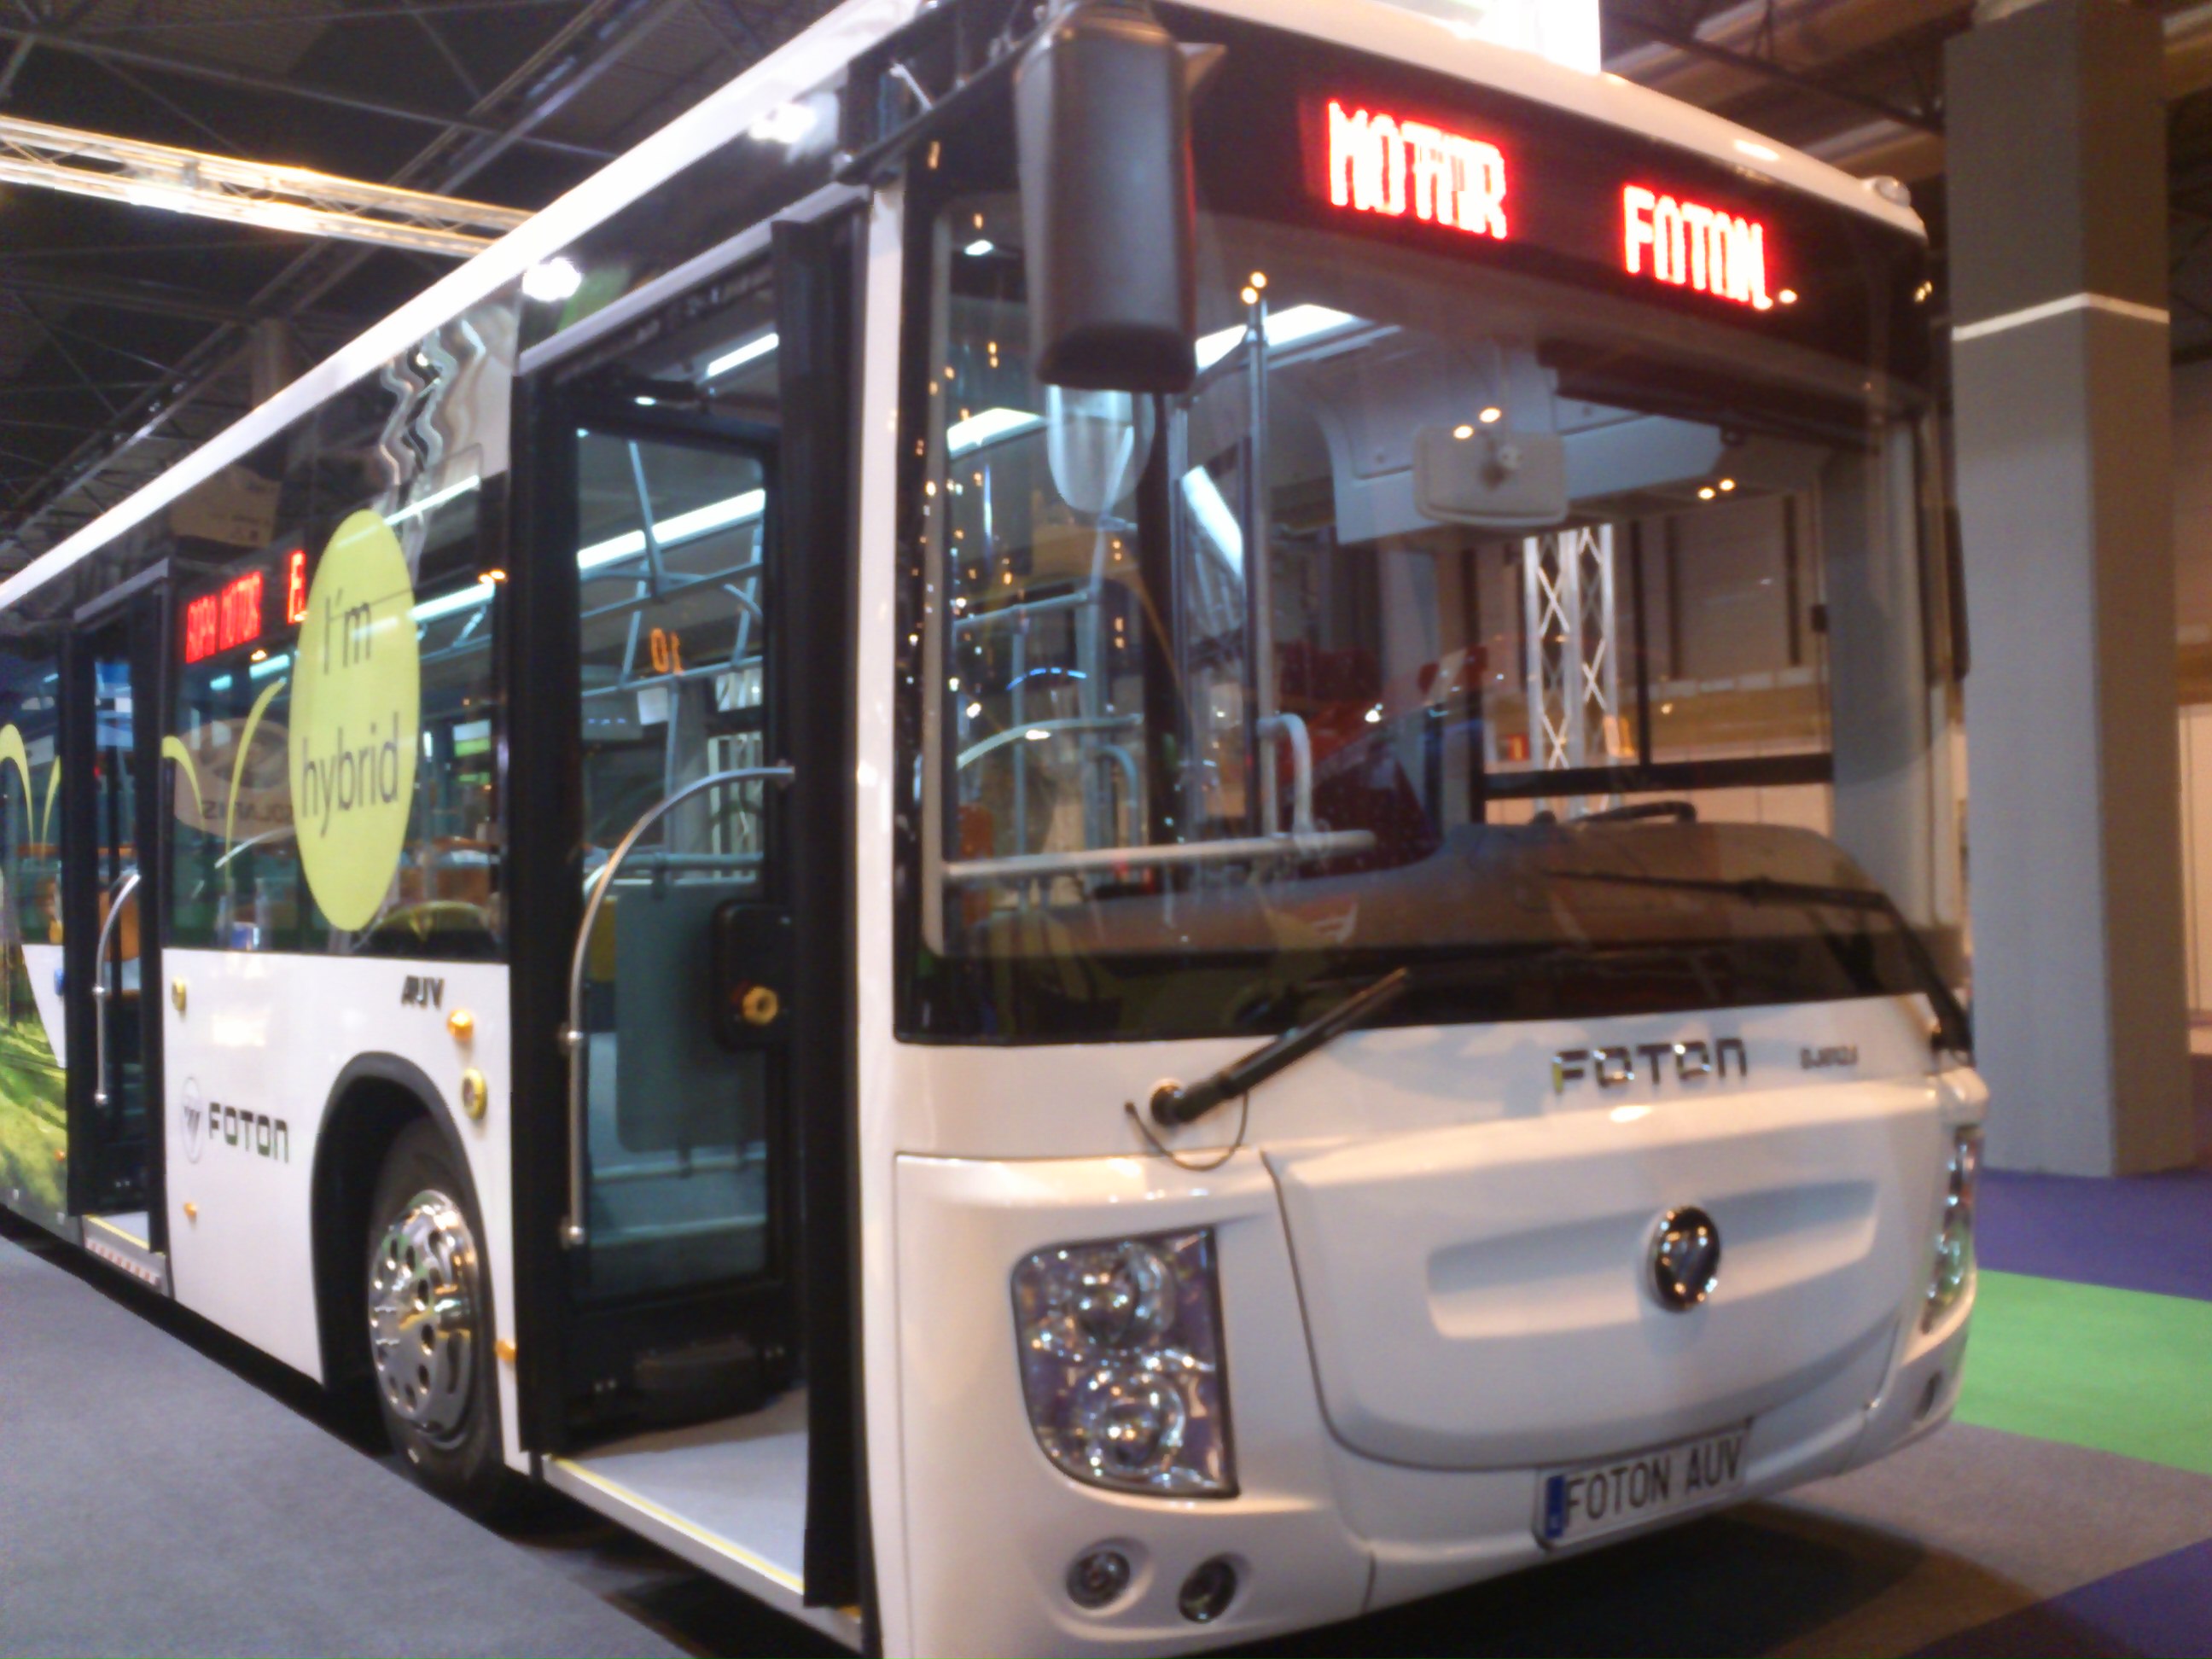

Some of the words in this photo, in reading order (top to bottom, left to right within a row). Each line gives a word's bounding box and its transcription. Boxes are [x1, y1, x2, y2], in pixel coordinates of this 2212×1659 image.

[1623, 184, 1767, 306] FOTON
[302, 711, 399, 838] hybrid
[1551, 1036, 1748, 1095] FOTON
[208, 1101, 289, 1164] FOTON
[1566, 1453, 1671, 1528] FOTON
[1685, 1436, 1743, 1495] AUV
